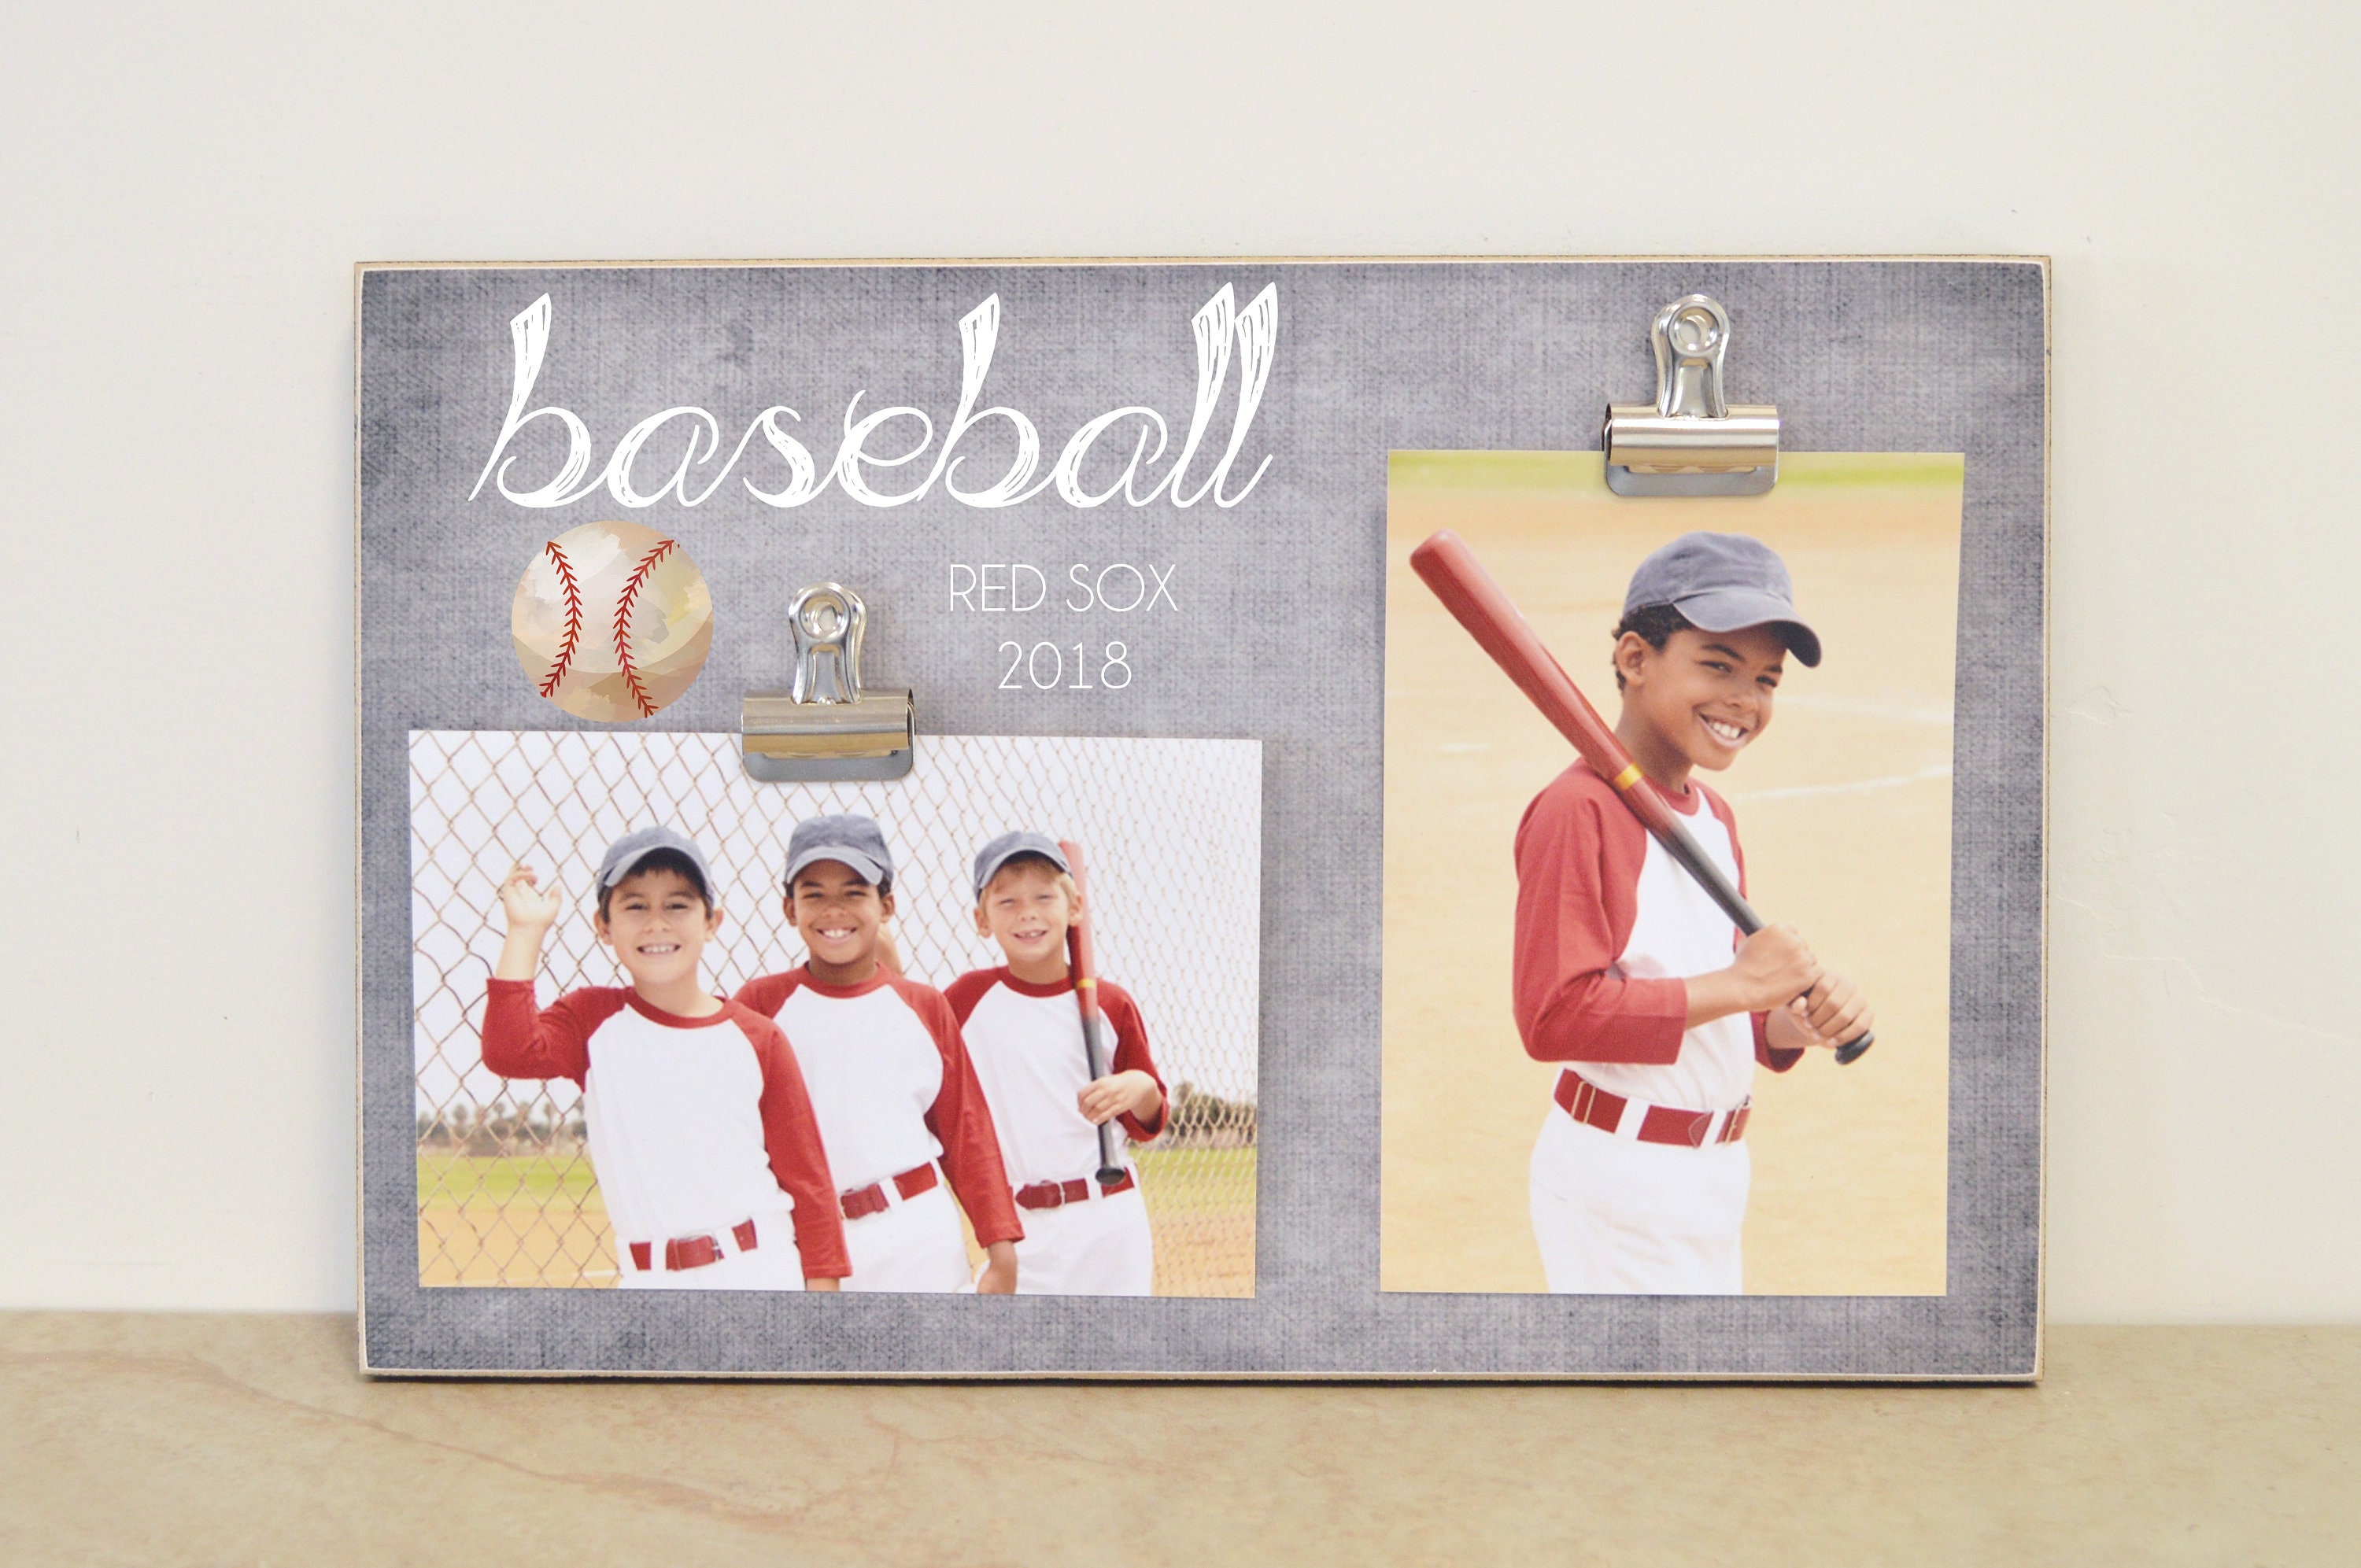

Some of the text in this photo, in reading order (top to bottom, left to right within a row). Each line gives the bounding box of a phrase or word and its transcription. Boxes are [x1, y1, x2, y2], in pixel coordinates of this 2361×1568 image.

[468, 282, 1279, 507] baseball
[949, 563, 1179, 612] RED SOX
[998, 641, 1132, 690] 2018
